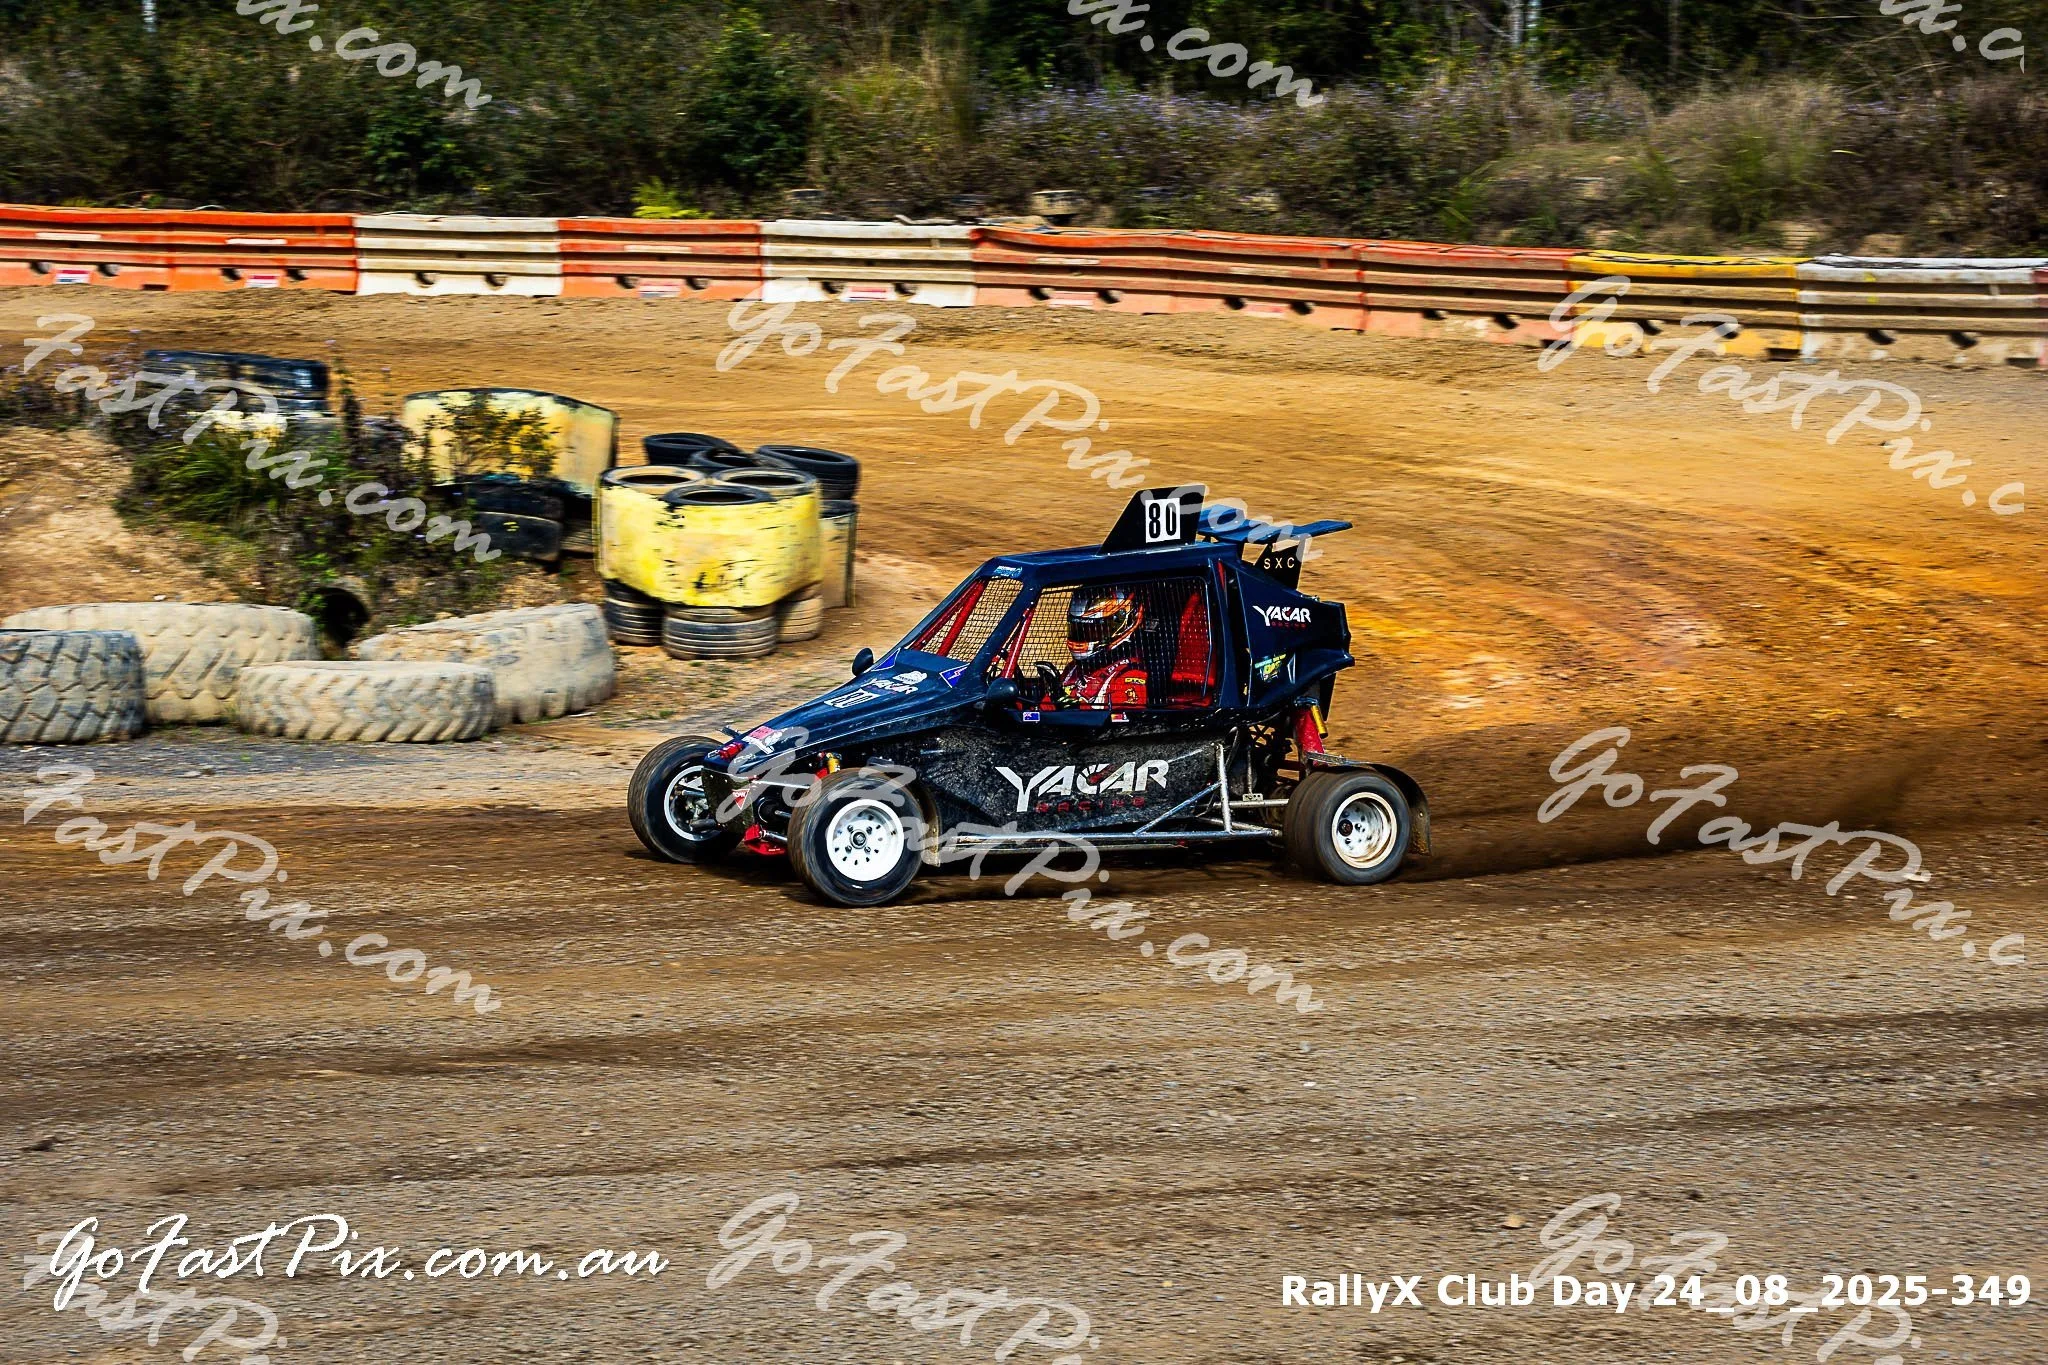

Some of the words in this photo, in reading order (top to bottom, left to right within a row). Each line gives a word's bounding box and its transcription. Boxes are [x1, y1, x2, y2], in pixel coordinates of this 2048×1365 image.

[1149, 502, 1177, 539] 80
[1252, 605, 1312, 627] YACAR
[995, 759, 1170, 813] YACAR
